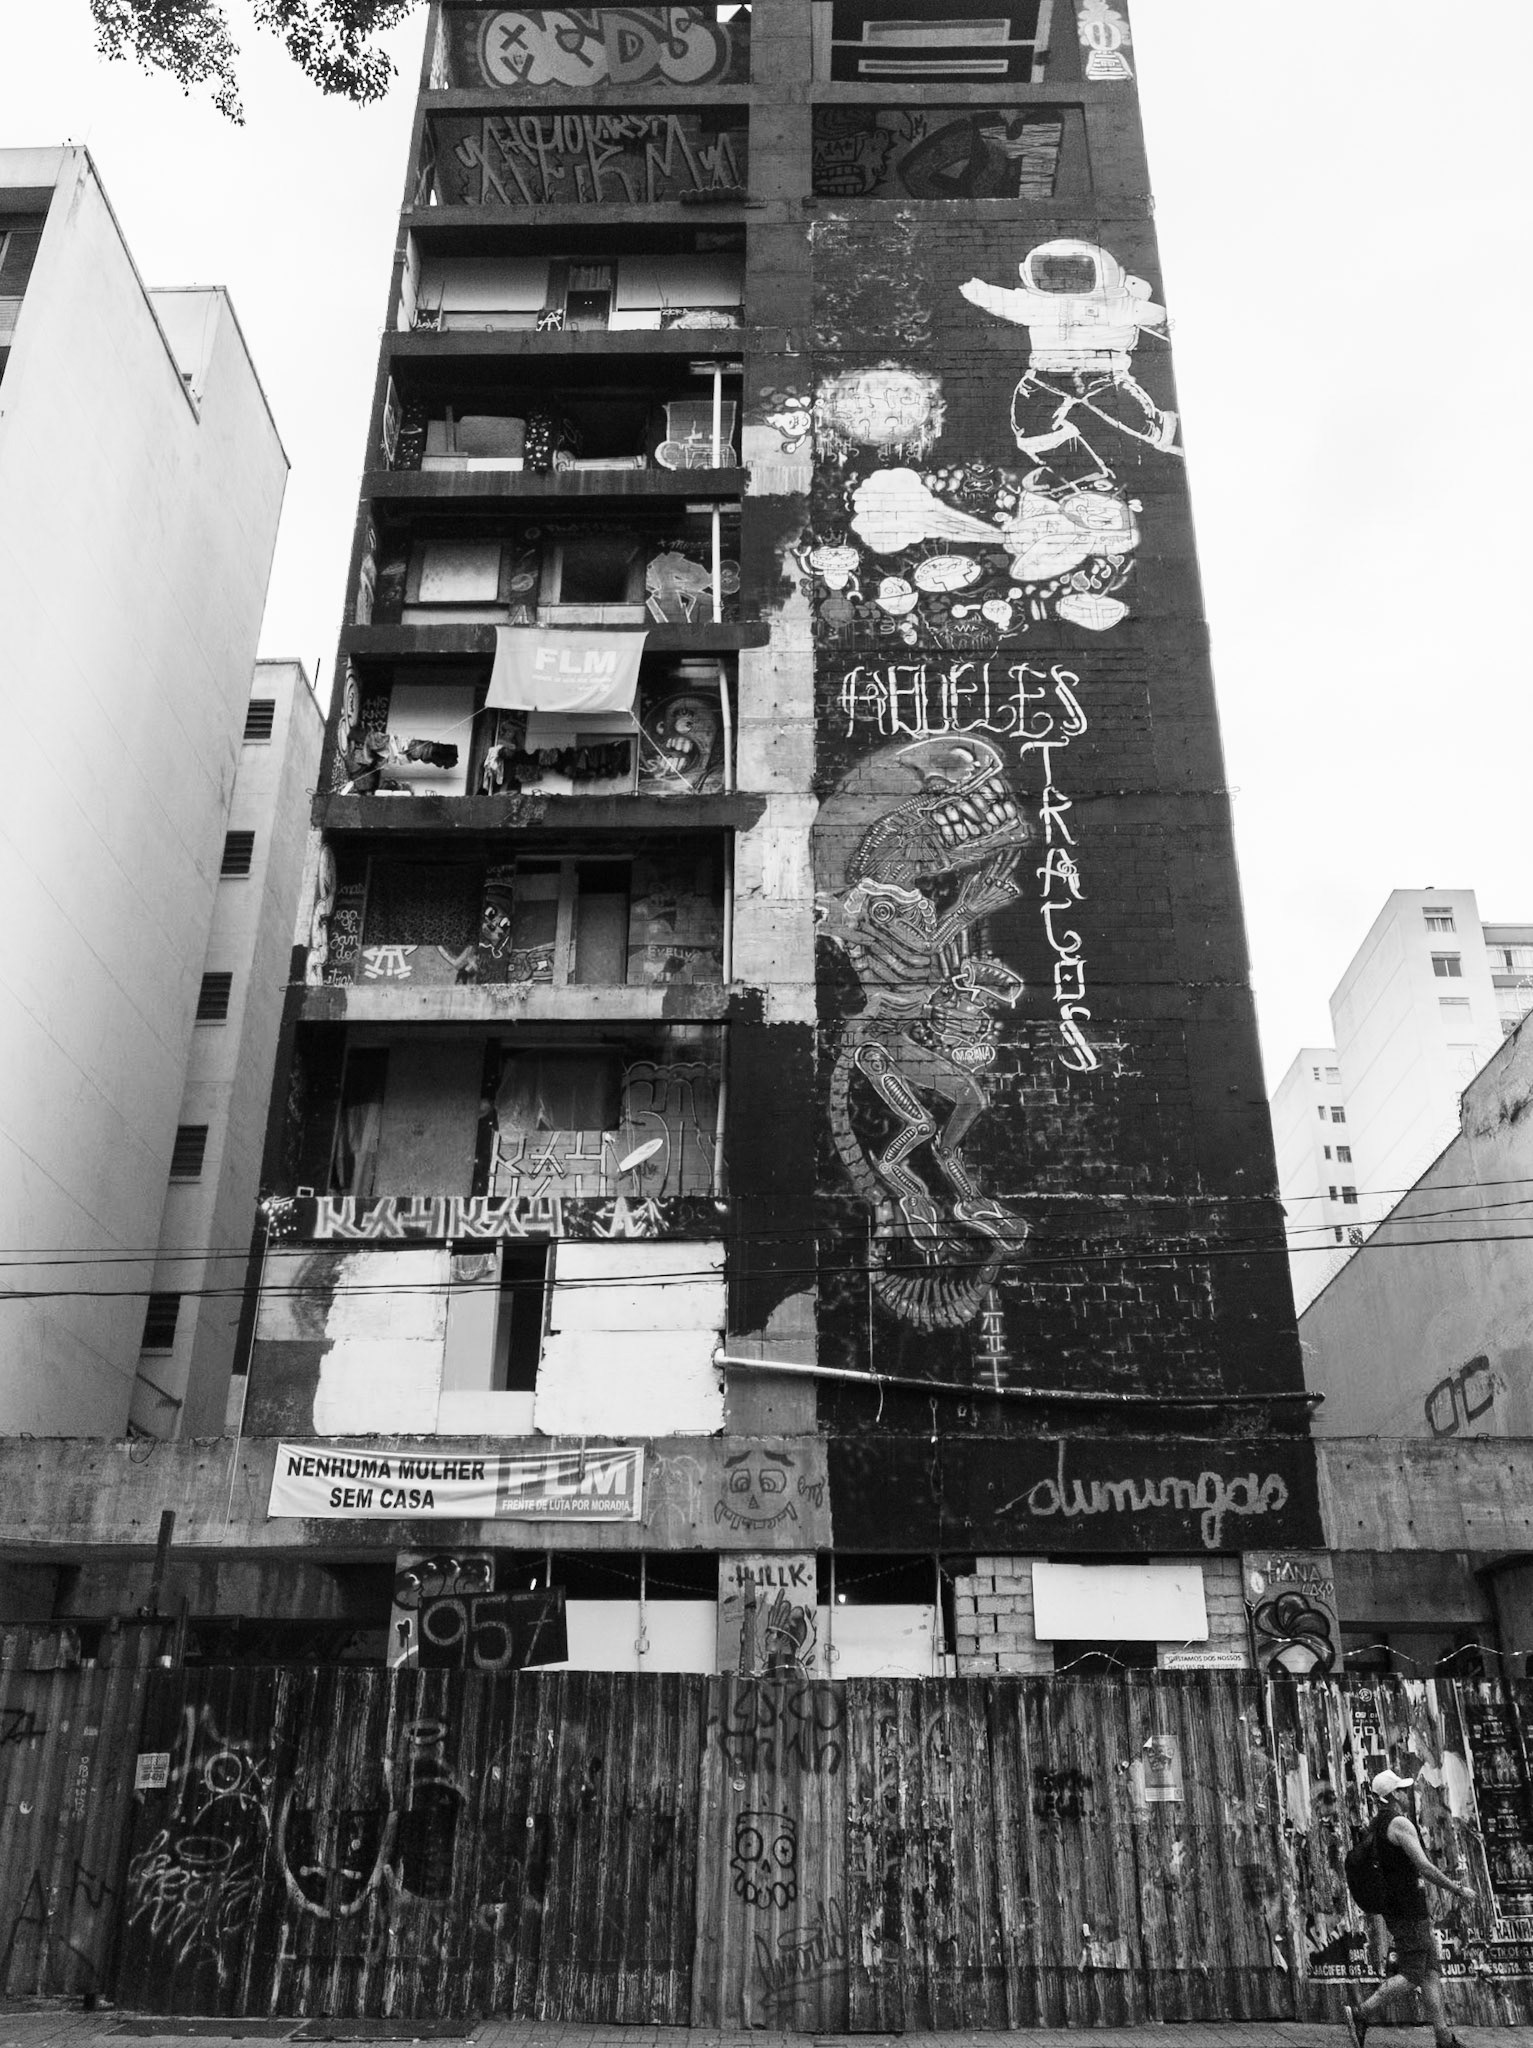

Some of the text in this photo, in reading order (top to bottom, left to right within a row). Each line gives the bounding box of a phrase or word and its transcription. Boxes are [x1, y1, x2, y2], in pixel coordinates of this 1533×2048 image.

[535, 647, 617, 673] FLM
[287, 1457, 485, 1480] NENHUMA MULHER
[508, 1461, 628, 1495] FLM
[330, 1487, 434, 1509] SEM CASA
[502, 1500, 630, 1511] FRENTE DE LUTA POR MORADIA
[422, 1594, 557, 1671] 957
